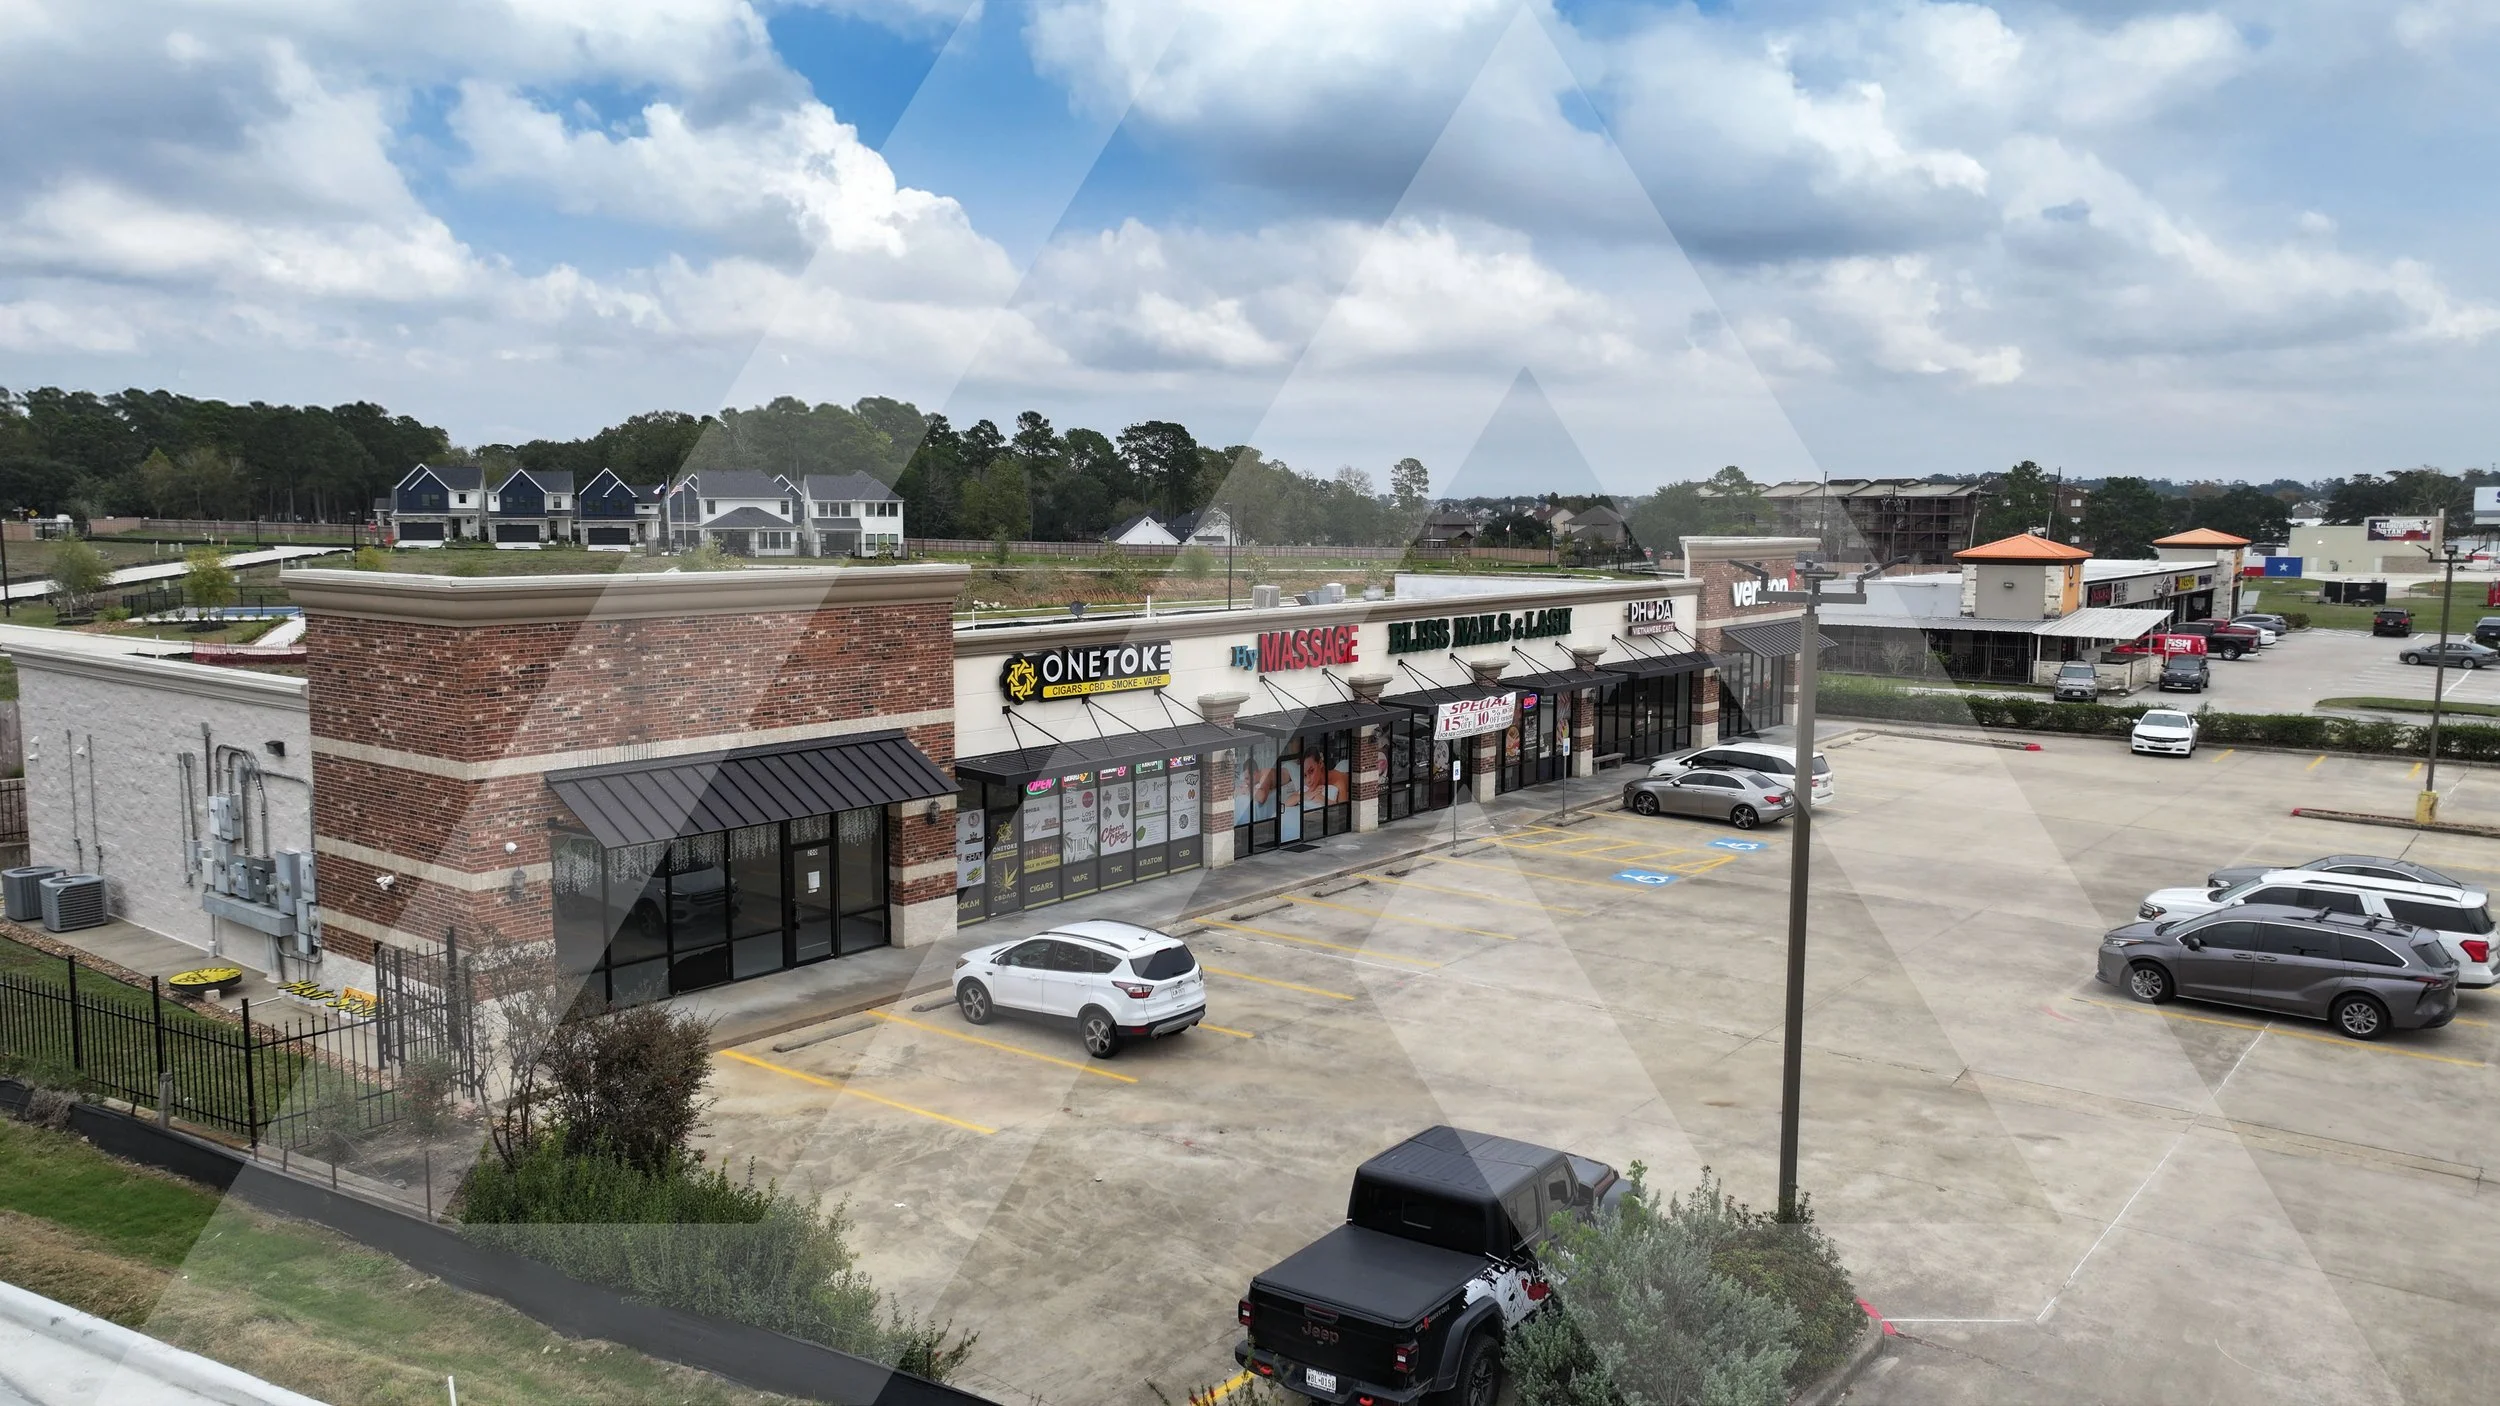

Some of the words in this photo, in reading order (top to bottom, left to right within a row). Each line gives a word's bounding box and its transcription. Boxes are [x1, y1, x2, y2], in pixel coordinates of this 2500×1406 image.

[1388, 618, 1450, 654] BLISS
[1452, 613, 1512, 648] NAILS
[1513, 618, 1523, 640] &
[1524, 608, 1572, 639] LASH
[1231, 645, 1258, 671] Hy
[1258, 625, 1359, 673] MASSAGE
[1042, 644, 1172, 683] ONETOKE
[1052, 684, 1083, 696] CIGARS
[1089, 683, 1105, 692] CBD
[1111, 678, 1138, 689] SMOKE
[1144, 675, 1162, 685] VAPE
[1450, 697, 1509, 715] SPECIAL
[1461, 721, 1472, 730] OFF
[1490, 716, 1500, 724] OFF
[1028, 779, 1053, 792] OPEN
[1179, 849, 1191, 857] CBD
[1139, 856, 1163, 866] KRATOM
[1110, 865, 1123, 874] THC
[1072, 873, 1089, 883] VAPE
[1029, 881, 1054, 893] CIGARS
[1301, 1321, 1340, 1345] Jeep
